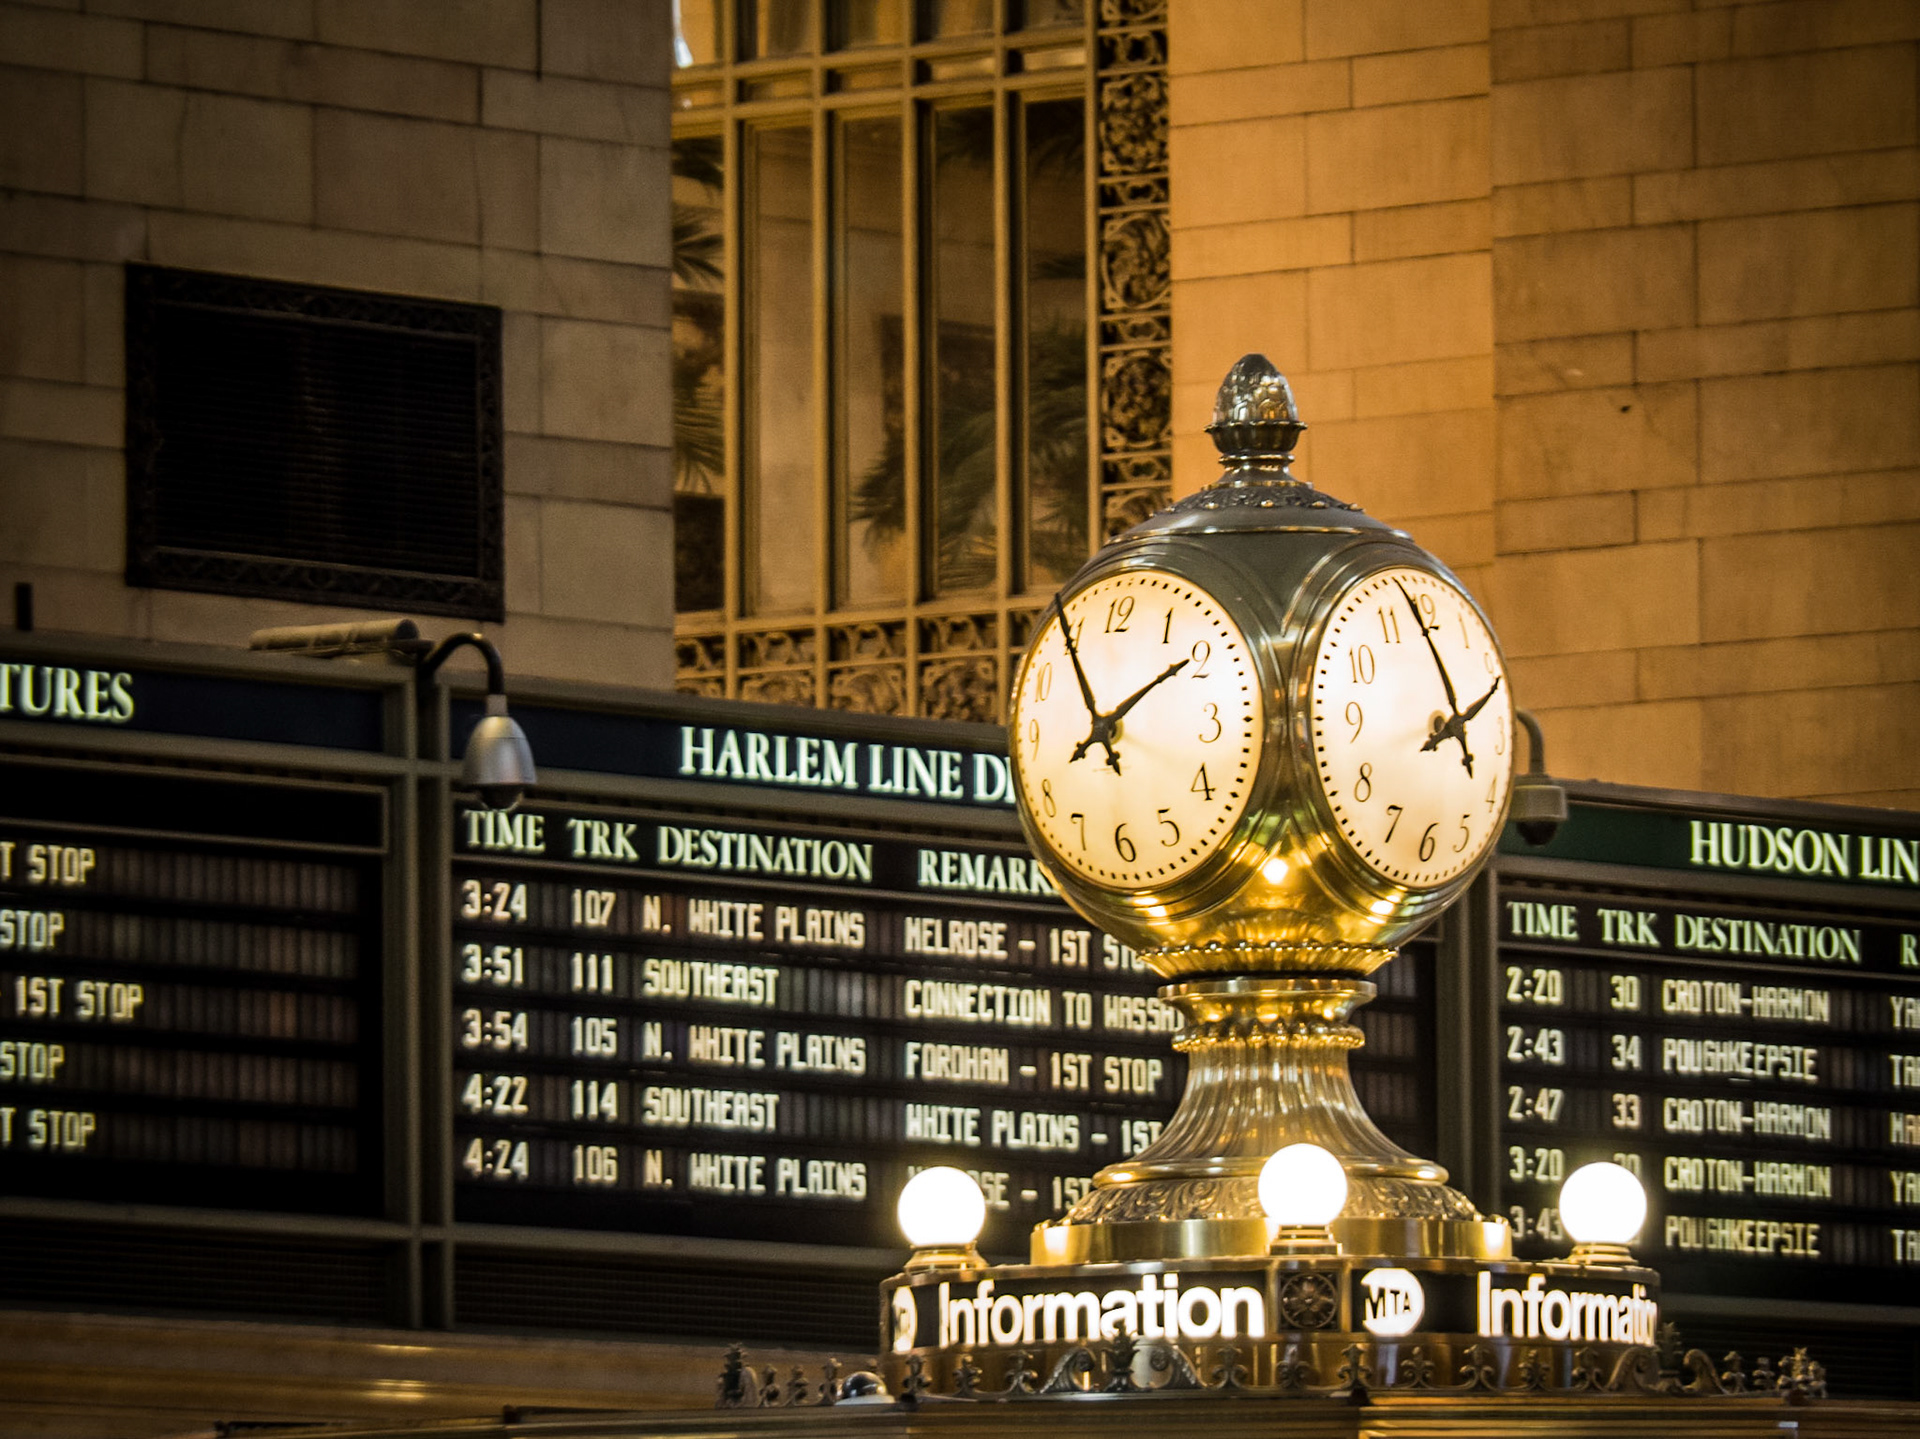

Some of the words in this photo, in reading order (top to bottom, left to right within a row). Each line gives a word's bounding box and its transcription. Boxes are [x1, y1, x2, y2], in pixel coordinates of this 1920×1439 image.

[1103, 594, 1135, 634] 12
[1162, 607, 1174, 644] 1
[1378, 606, 1401, 644] 11
[1191, 640, 1211, 678] 2
[1350, 645, 1375, 685] 10
[1035, 663, 1052, 703] 10
[1029, 719, 1039, 761] 9
[1199, 703, 1221, 743] 3
[1346, 702, 1363, 743] 9
[681, 727, 858, 789] HARLEM
[869, 745, 963, 798] LINE
[1191, 763, 1215, 800] 4
[1042, 779, 1056, 817] 8
[1354, 763, 1372, 803] 8
[1071, 813, 1086, 851] 7
[1115, 823, 1136, 862] 6
[1158, 808, 1180, 846] 5
[1386, 804, 1402, 843] 7
[1419, 823, 1439, 862] 6
[1453, 813, 1470, 853] 5
[28, 845, 95, 885] STOP
[465, 809, 545, 851] TIME
[568, 819, 638, 860] TRK
[659, 826, 872, 885] DESTINATION
[1691, 821, 1849, 876] HUDSON
[1860, 836, 1919, 883] LIN
[0, 909, 64, 949] STOP
[463, 880, 526, 920] 3:24
[573, 889, 615, 927] 107
[643, 896, 671, 933] N.
[689, 899, 763, 941] WHITE
[776, 906, 865, 948] PLAINS
[905, 917, 1008, 960] MELROSE
[1050, 929, 1091, 967] 1ST
[1102, 932, 1152, 975] ST
[1507, 902, 1578, 939] TIME
[1597, 909, 1659, 946] TRK
[1676, 915, 1859, 961] DESTINATION
[16, 976, 63, 1015] 1ST
[77, 981, 143, 1020] STOP
[463, 944, 523, 985] 3:51
[573, 953, 612, 992] 111
[644, 959, 779, 1005] SOUTHEAST
[905, 980, 1051, 1026] CONNECTION
[1062, 991, 1091, 1029] TO
[1507, 967, 1563, 1005] 2:20
[1611, 975, 1640, 1010] 30
[1662, 979, 1830, 1022] CROTON-HARMON
[0, 1041, 64, 1080] STOP
[464, 1009, 527, 1049] 3:54
[573, 1017, 616, 1056] 105
[643, 1022, 672, 1060] N.
[689, 1026, 765, 1067] WHITE
[776, 1032, 866, 1075] PLAINS
[906, 1042, 1009, 1085] FORDHAM
[1051, 1052, 1091, 1090] 1ST
[1104, 1057, 1162, 1094] STOP
[1508, 1026, 1564, 1064] 2:43
[1612, 1035, 1640, 1069] 34
[1663, 1038, 1817, 1082] POUGHKEEPSIE
[29, 1109, 95, 1148] STOP
[463, 1074, 528, 1114] 4:22
[573, 1080, 617, 1120] 114
[644, 1087, 779, 1131] SOUTHEAST
[906, 1104, 980, 1146] WHITE
[992, 1110, 1079, 1151] PLAINS
[1509, 1086, 1563, 1122] 2:47
[1613, 1094, 1641, 1128] 33
[1664, 1098, 1830, 1139] CROTON-HARMON
[464, 1138, 528, 1177] 4:24
[574, 1145, 617, 1184] 106
[644, 1150, 672, 1186] N.
[690, 1153, 765, 1194] WHITE
[777, 1158, 866, 1200] PLAINS
[1509, 1146, 1564, 1182] 3:20
[1664, 1157, 1831, 1197] CROTON-HARMON
[1665, 1216, 1820, 1256] POUGHKEEPSIE
[939, 1272, 1266, 1349] Information
